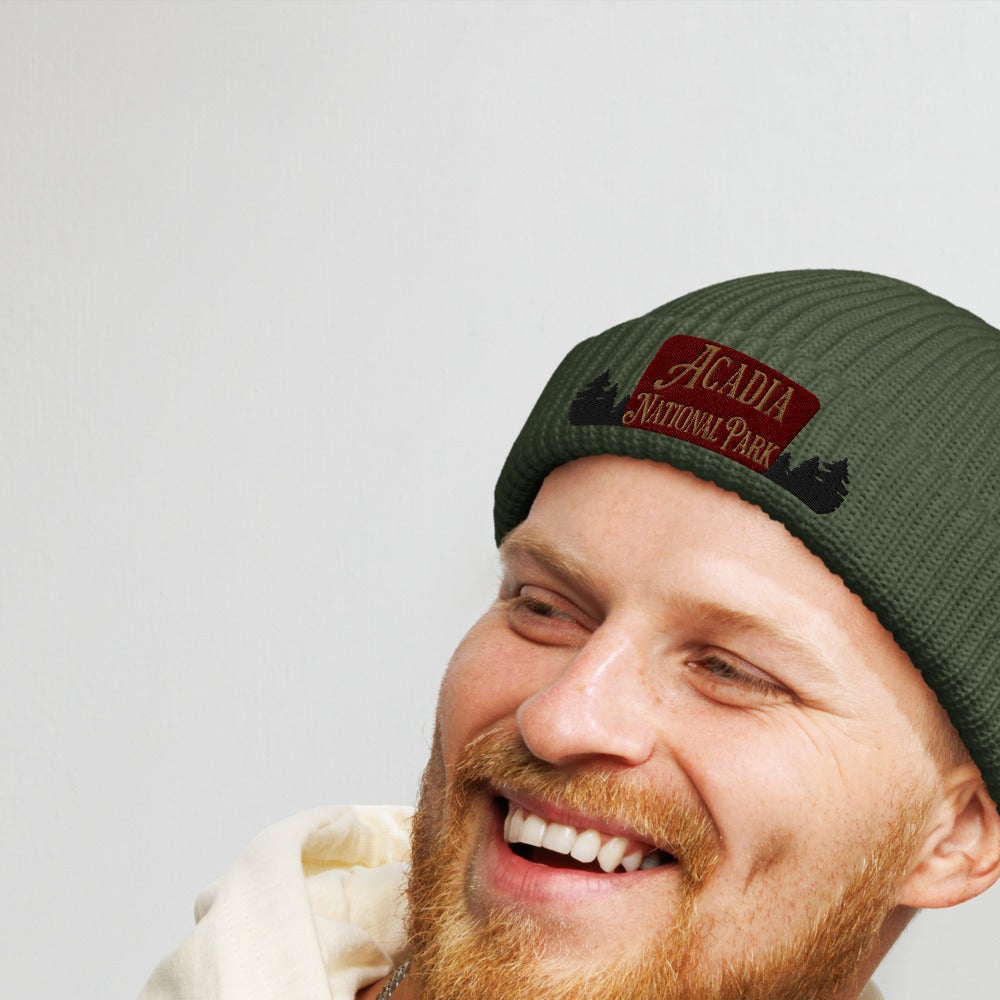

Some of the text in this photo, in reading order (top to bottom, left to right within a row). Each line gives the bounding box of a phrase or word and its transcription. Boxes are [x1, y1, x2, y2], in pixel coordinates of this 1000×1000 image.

[653, 344, 795, 424] ACADIA
[622, 392, 780, 470] NATIONAL PARK
